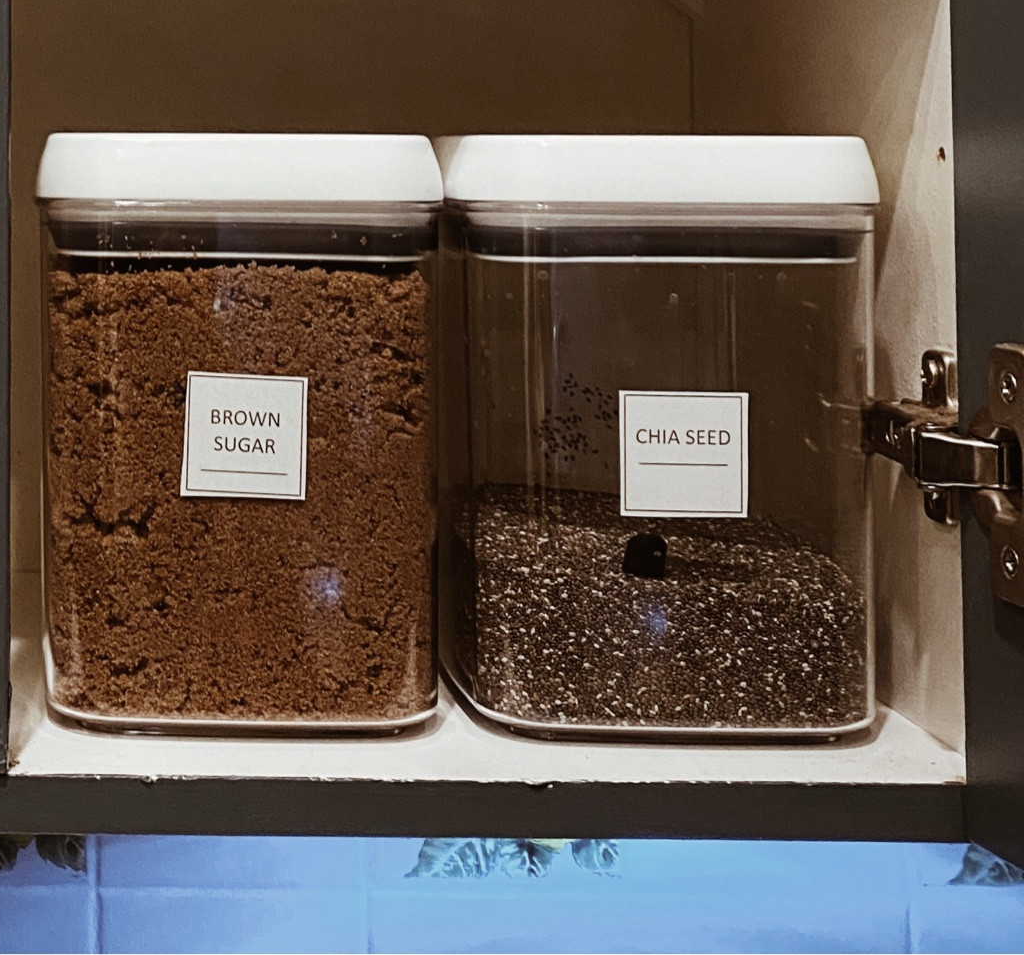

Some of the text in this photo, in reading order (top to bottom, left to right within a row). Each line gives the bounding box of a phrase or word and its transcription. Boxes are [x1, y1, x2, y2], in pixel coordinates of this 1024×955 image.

[210, 408, 281, 428] BROWN
[213, 435, 276, 455] SUGAR
[635, 428, 731, 446] CHIA SEED
